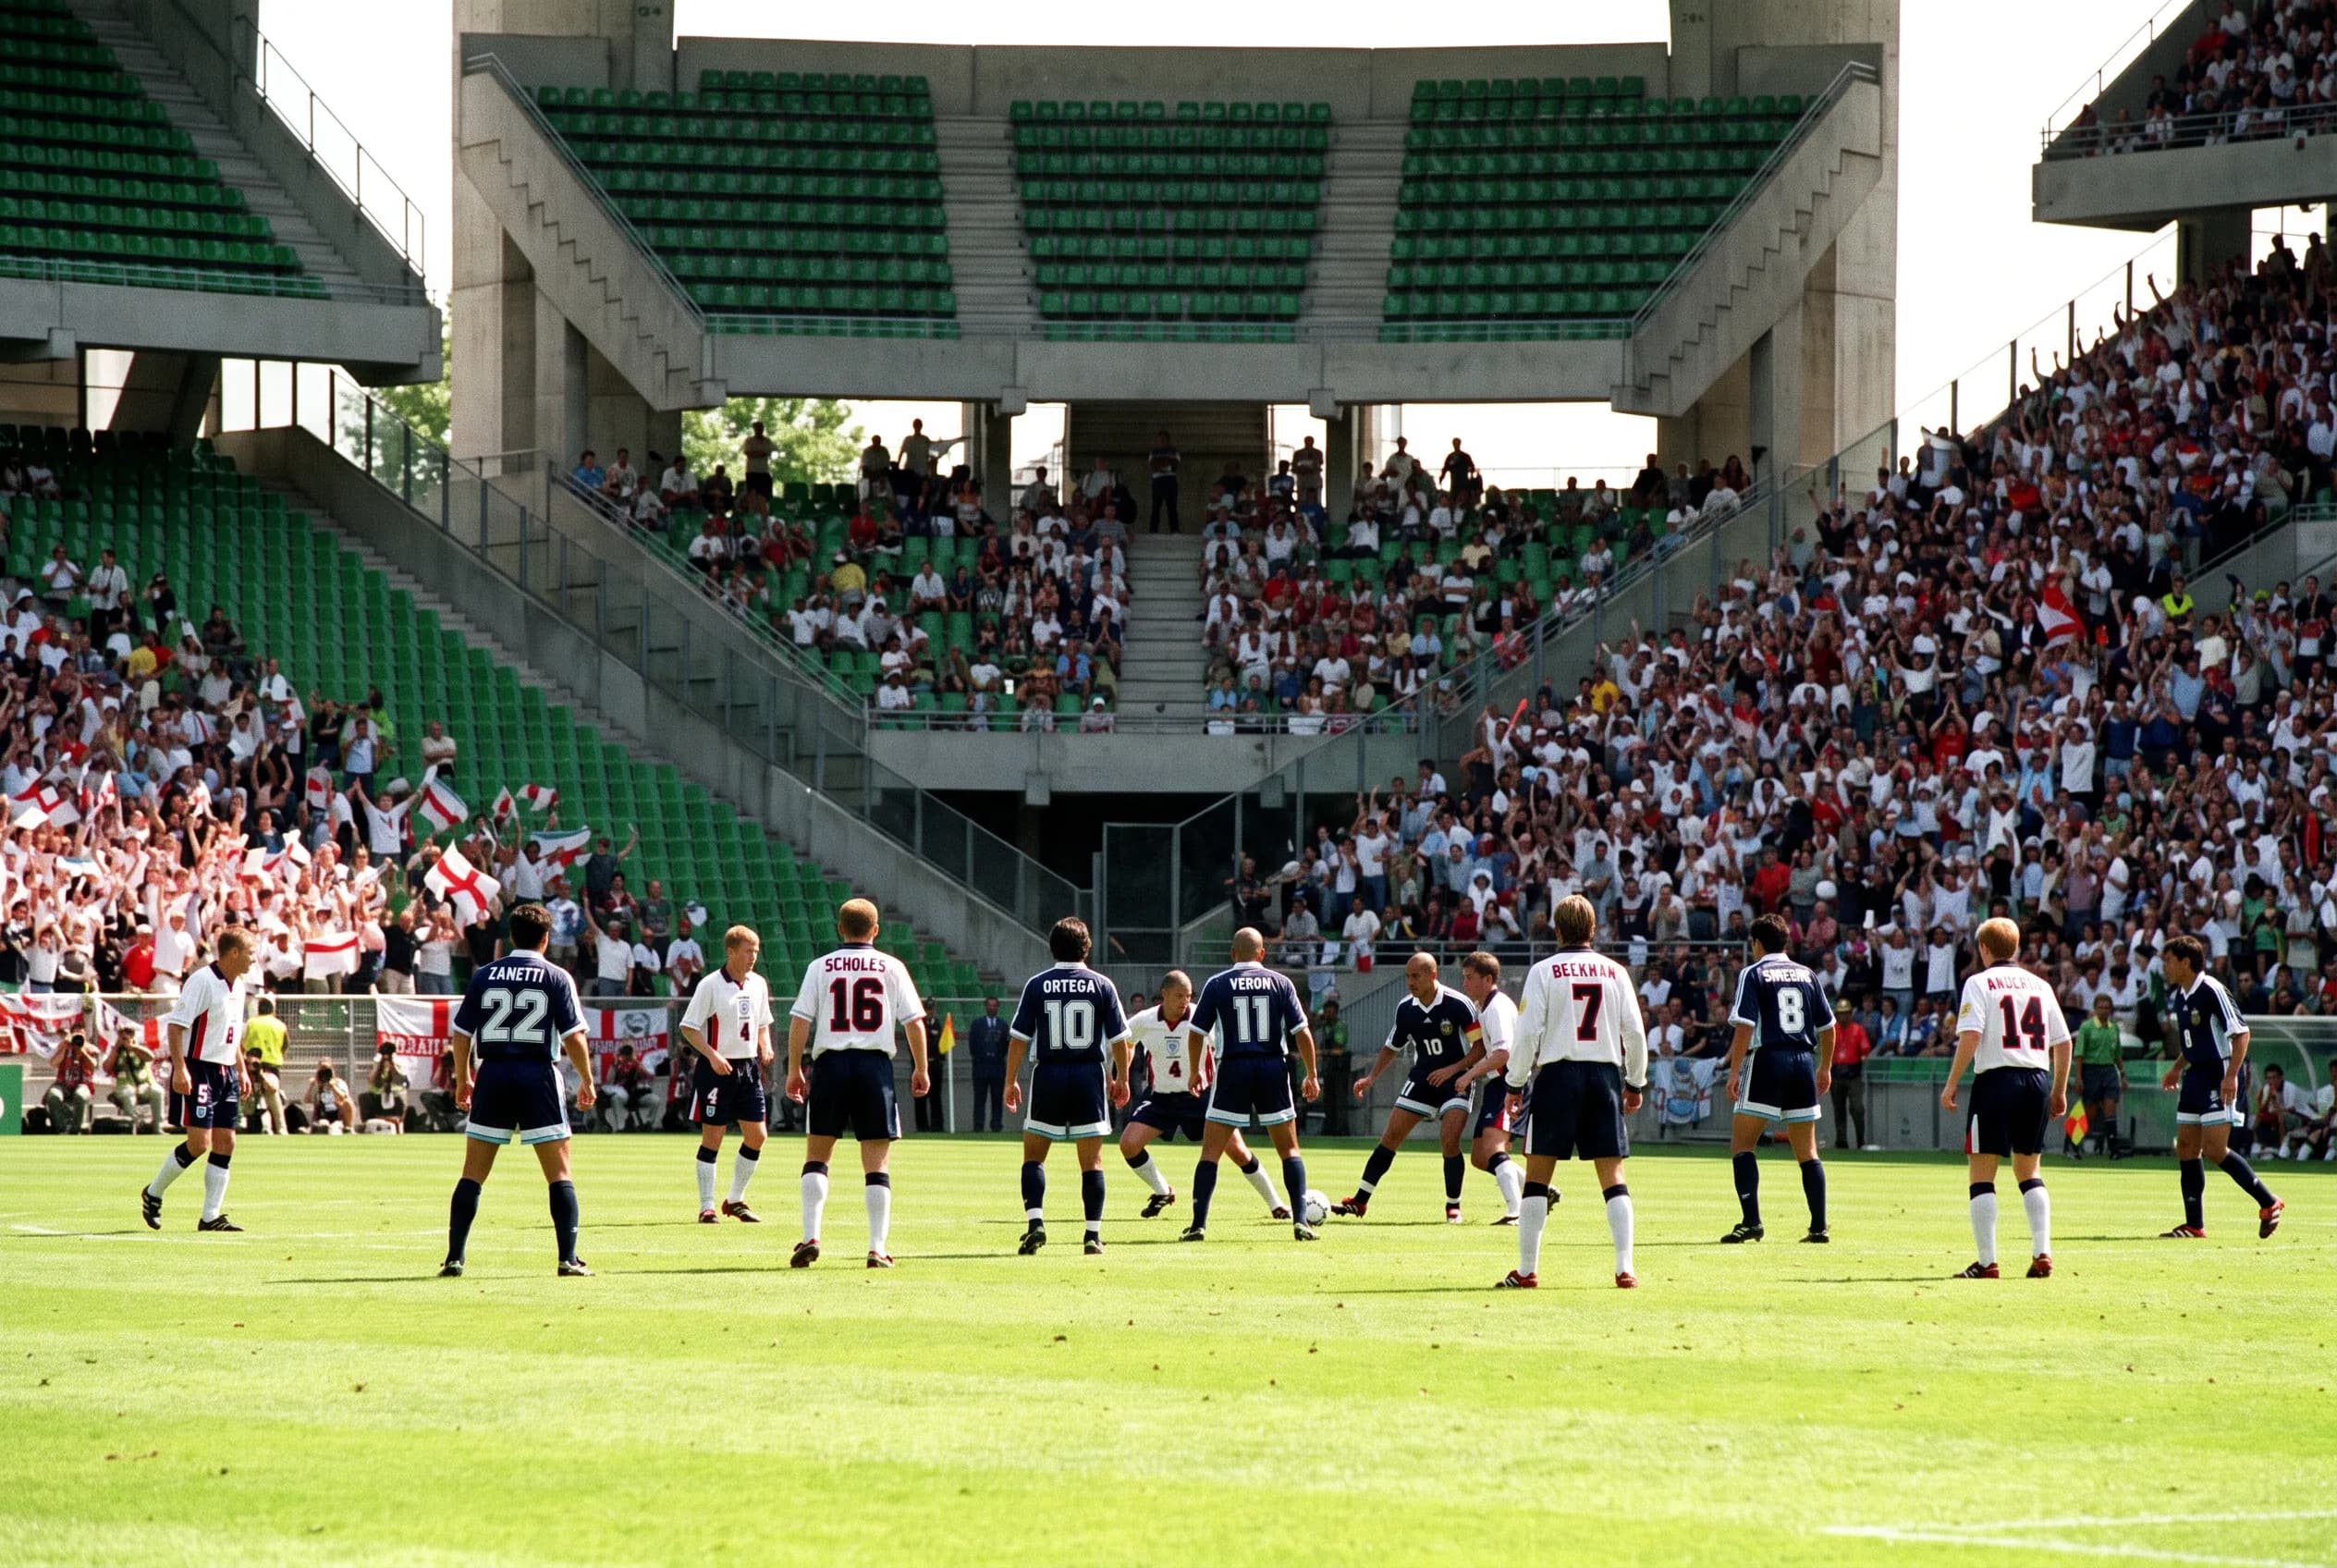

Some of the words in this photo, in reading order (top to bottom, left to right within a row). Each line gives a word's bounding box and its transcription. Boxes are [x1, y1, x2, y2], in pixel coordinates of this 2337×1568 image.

[488, 966, 544, 983] ZANETTI
[825, 957, 887, 973] SCHOLES
[1043, 979, 1095, 994] ORTEGA
[1230, 977, 1271, 991] VERON
[829, 977, 884, 1033] 16
[1572, 983, 1602, 1041] 7
[1777, 987, 1805, 1034] 8
[481, 987, 548, 1044] 22
[1045, 999, 1095, 1049] 10
[1232, 995, 1270, 1043] 11
[2000, 995, 2046, 1050] 14
[740, 1022, 751, 1041] 4
[1423, 1038, 1443, 1056] 10
[1168, 1060, 1181, 1078] 4
[197, 1084, 208, 1103] 5
[707, 1087, 719, 1104] 4
